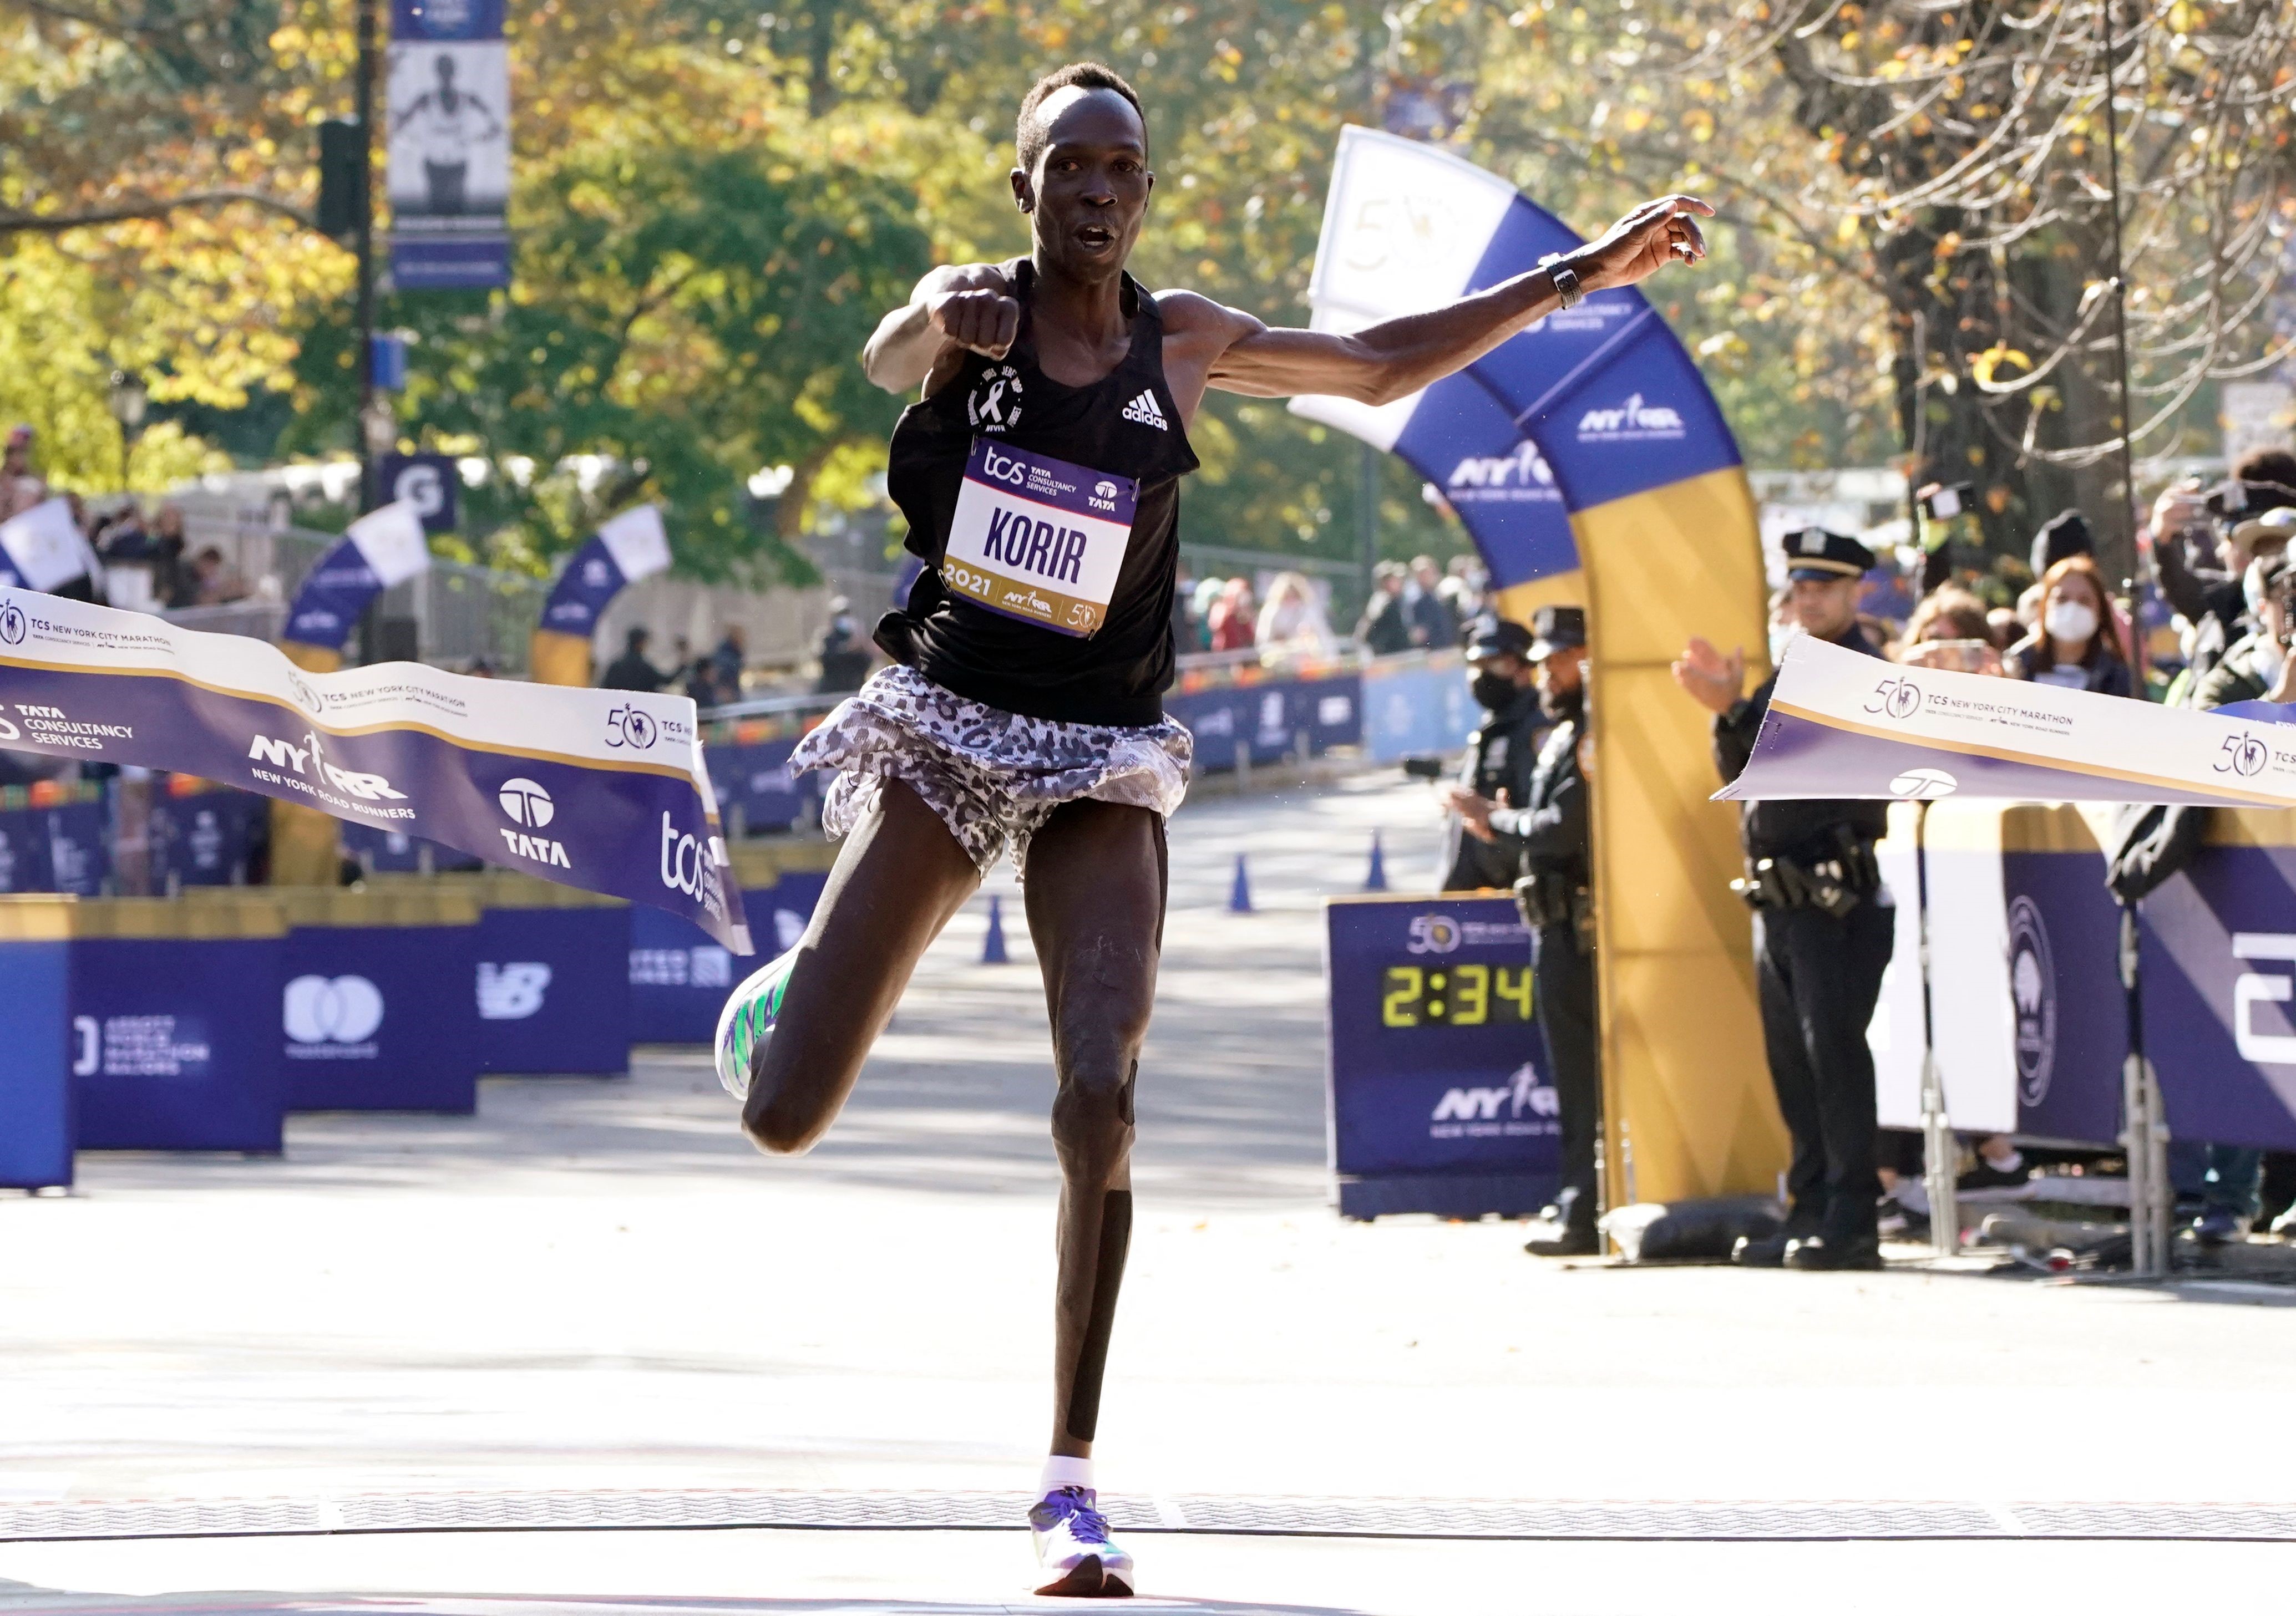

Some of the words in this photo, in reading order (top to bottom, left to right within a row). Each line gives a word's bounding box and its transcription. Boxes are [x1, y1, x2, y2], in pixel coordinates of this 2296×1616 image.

[1122, 407, 1168, 431] adidas
[984, 446, 1026, 485] tcs
[1031, 466, 1051, 478] TATA
[1026, 481, 1057, 496] SERVICES
[1028, 474, 1077, 493] CONSULTANCY
[1088, 496, 1116, 511] TATA
[983, 507, 1087, 585] KORIR
[945, 563, 991, 596] 2021
[31, 618, 50, 631] TCS
[53, 624, 72, 634] NEW
[74, 628, 97, 639] YORK
[99, 632, 118, 641] CITY
[121, 635, 171, 646] MARATHON
[323, 693, 347, 702] TCS
[350, 688, 375, 699] NEW
[376, 685, 405, 694] YORK
[1863, 678, 1920, 718] 50
[14, 704, 66, 719] TATA
[1928, 694, 1948, 706] TCS
[1950, 699, 1973, 710] NEW
[1973, 702, 1996, 713] YORK
[1997, 705, 2019, 716] CITY
[2019, 710, 2074, 726] MARATHON
[24, 719, 133, 739] CONSULTANCY
[32, 732, 103, 749] SERVICES
[605, 705, 657, 749] 50
[662, 721, 682, 733] TCS
[249, 731, 409, 800] NYRR
[2213, 732, 2267, 776] 50
[252, 768, 281, 785] NEW
[283, 775, 316, 796] YORK
[317, 789, 350, 809] ROAD
[352, 802, 416, 820] RUNNERS
[499, 827, 571, 869] TATA
[661, 810, 704, 903] tcs
[1383, 964, 1534, 1027] 2:34
